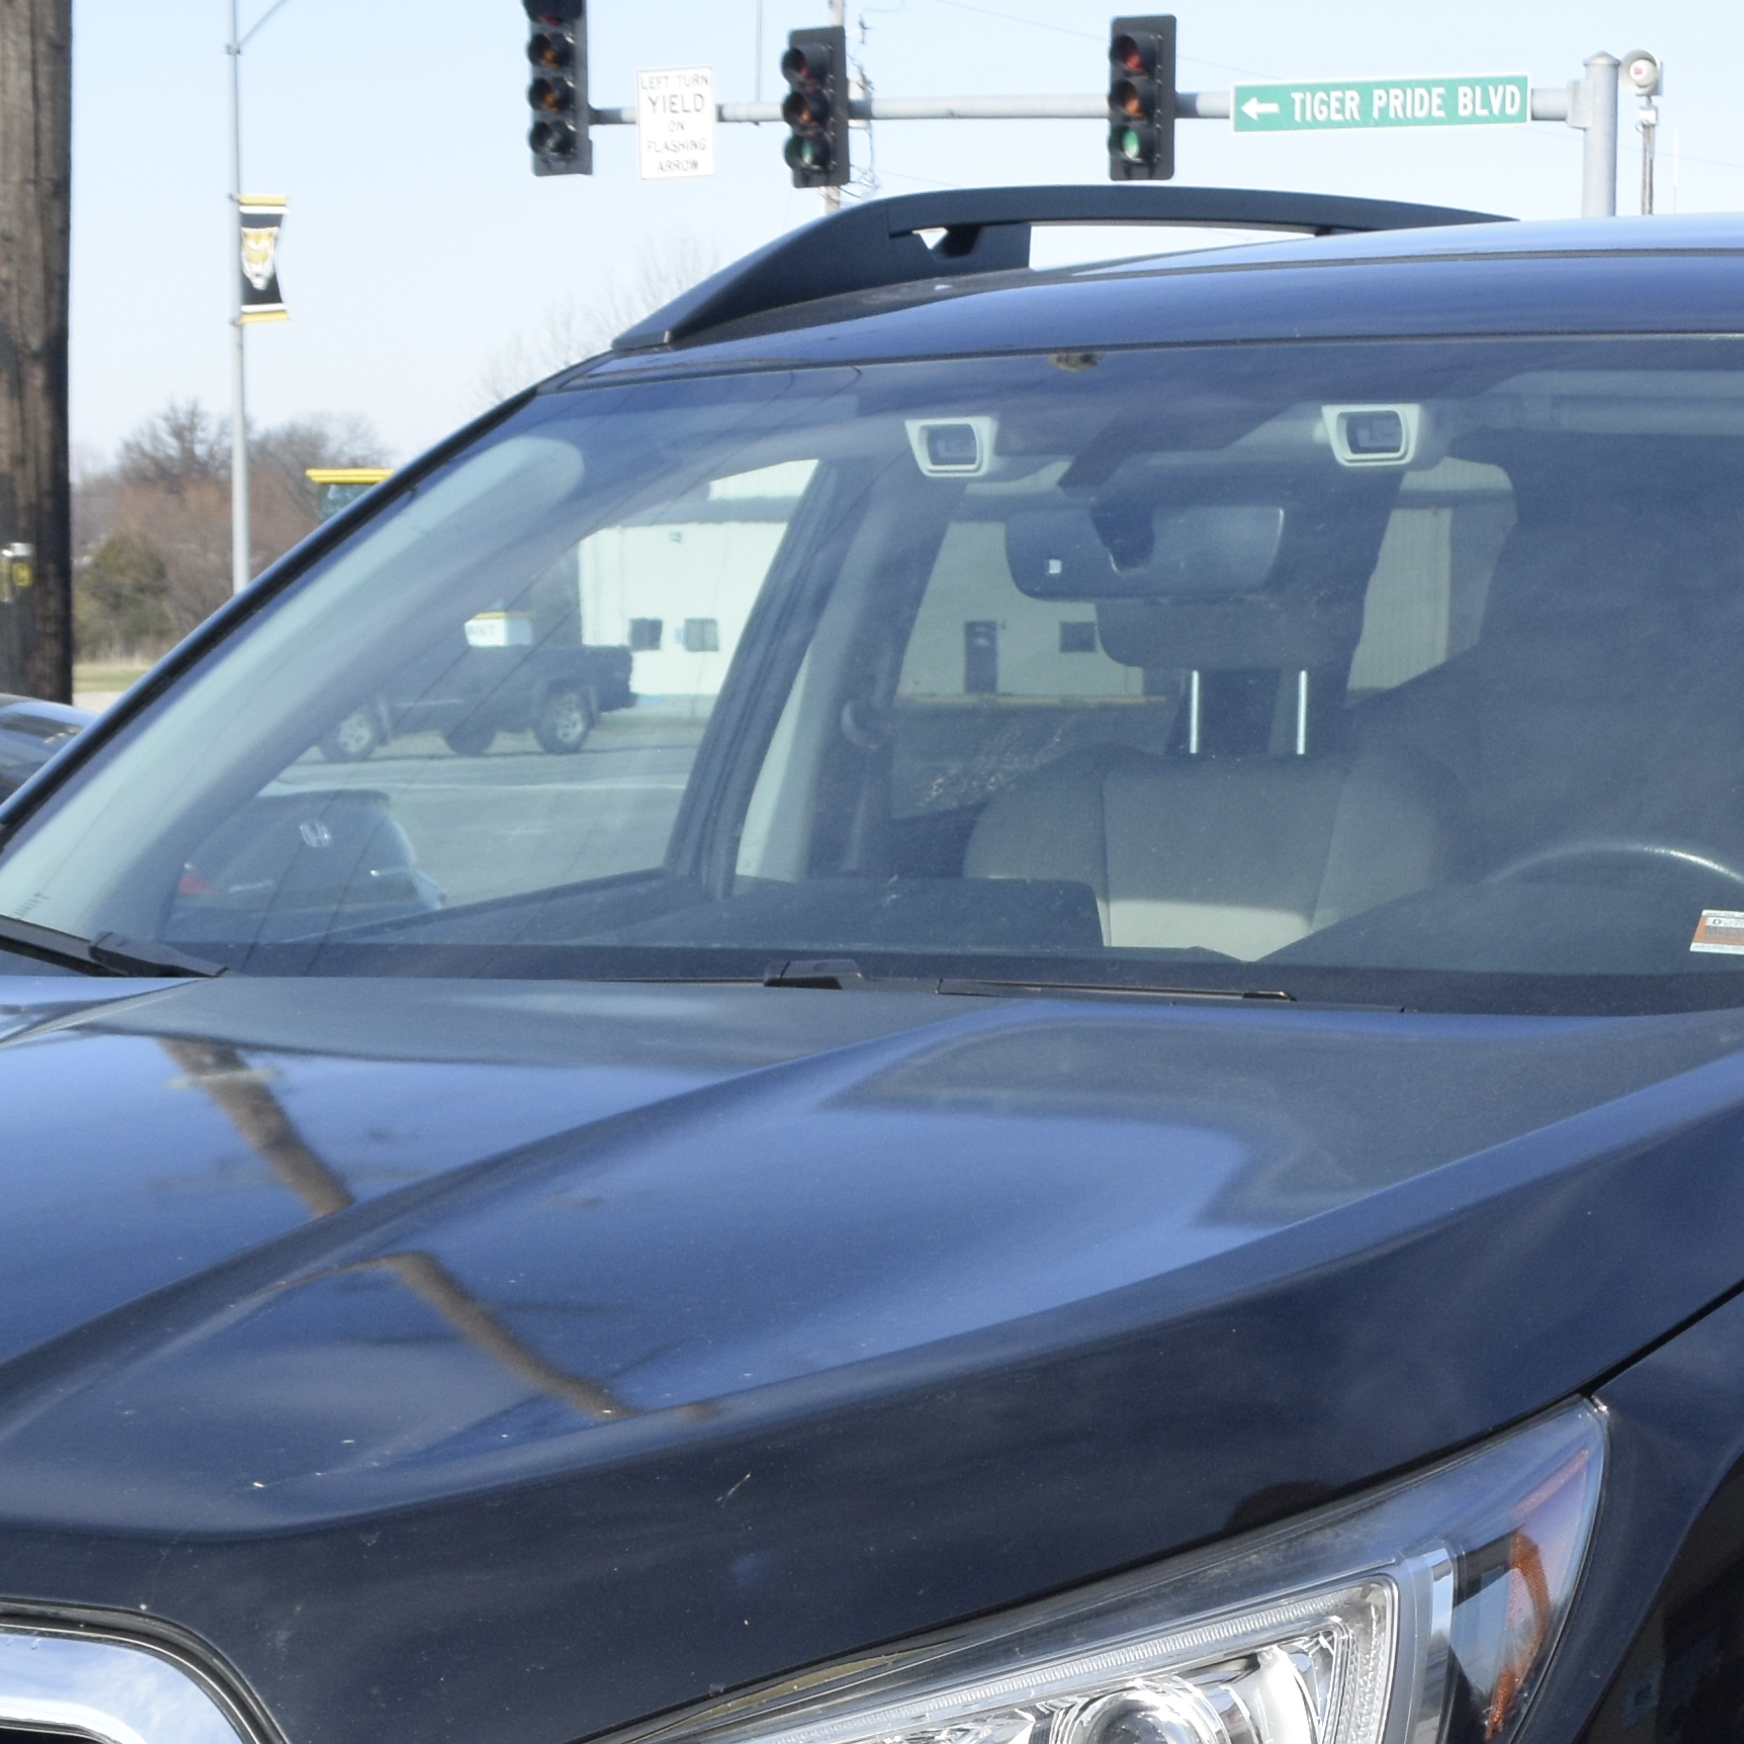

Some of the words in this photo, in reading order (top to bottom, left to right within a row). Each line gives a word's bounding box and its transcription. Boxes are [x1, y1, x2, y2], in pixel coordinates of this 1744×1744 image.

[640, 75, 669, 90] LEFT
[677, 73, 709, 88] TURN
[647, 92, 706, 114] YIELD
[1291, 90, 1361, 122] TIGER
[1372, 87, 1446, 120] PRIDE
[1458, 84, 1522, 117] BLVD
[668, 120, 686, 133] ON
[647, 137, 708, 153] FLASHING
[658, 159, 699, 172] ARROW
